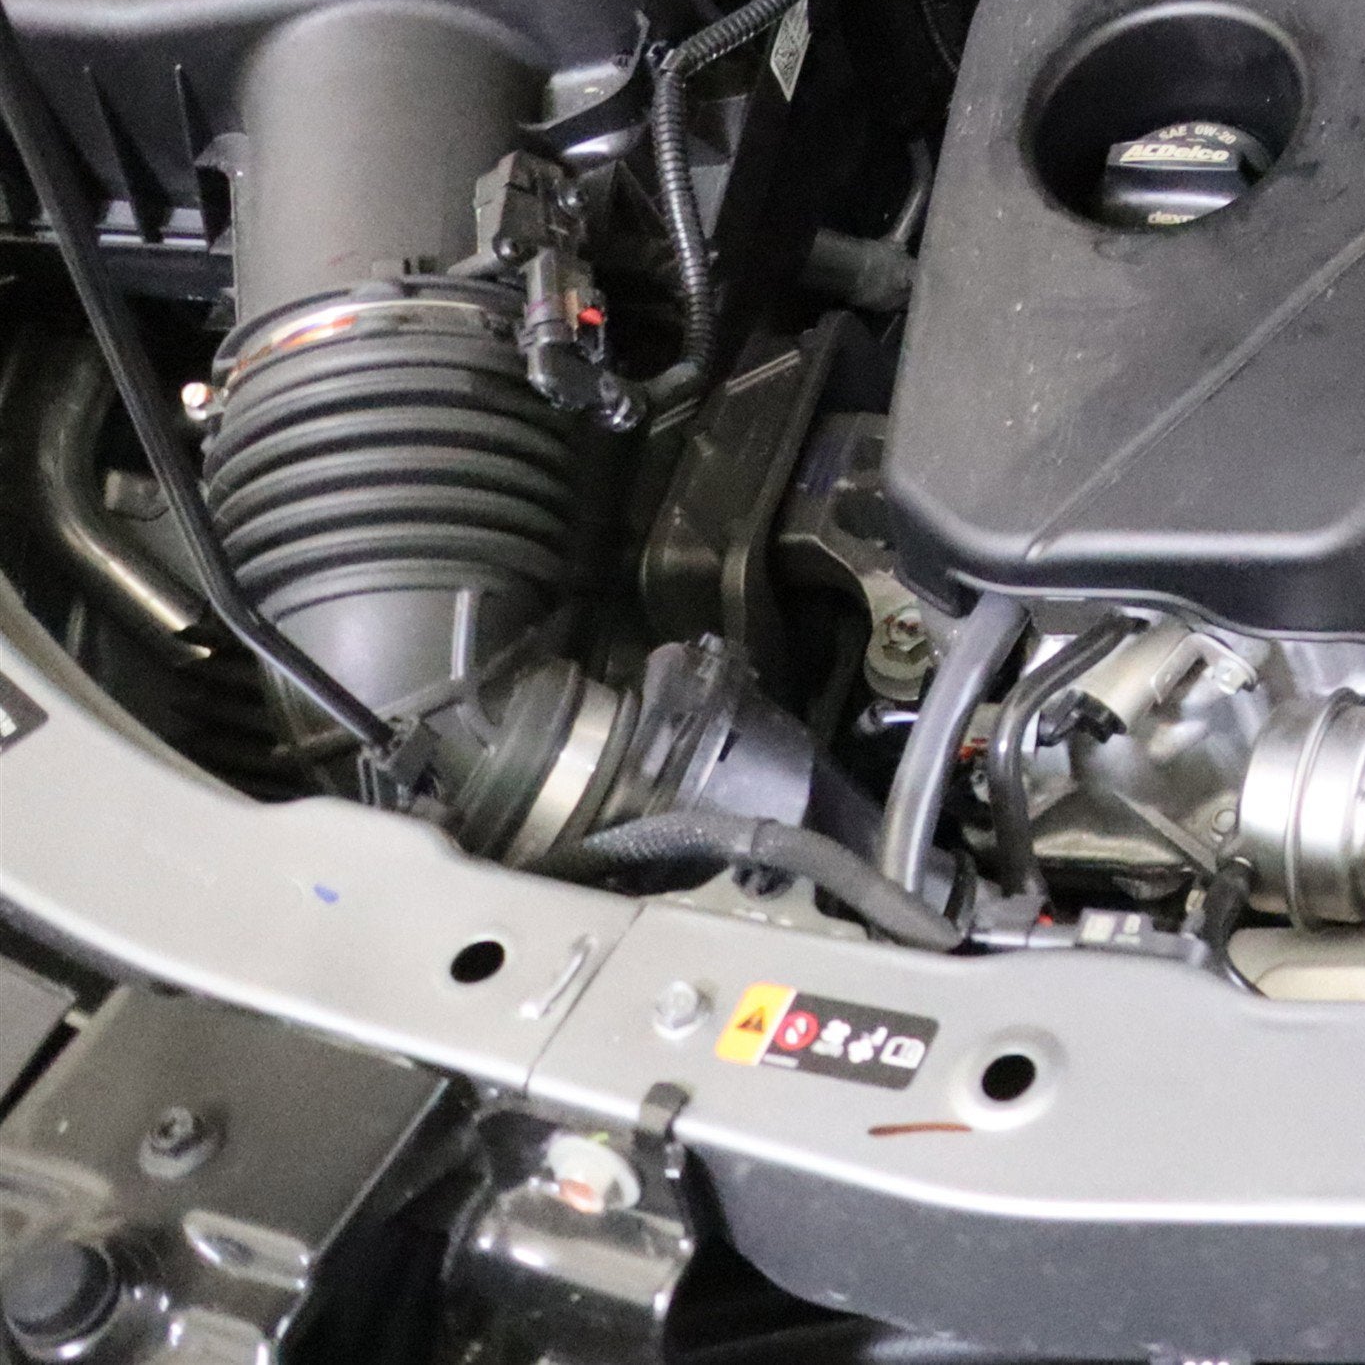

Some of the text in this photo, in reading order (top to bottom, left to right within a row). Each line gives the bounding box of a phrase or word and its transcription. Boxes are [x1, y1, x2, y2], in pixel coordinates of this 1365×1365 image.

[1158, 124, 1237, 145] SAE 0W-20
[1119, 143, 1230, 163] ACDelco
